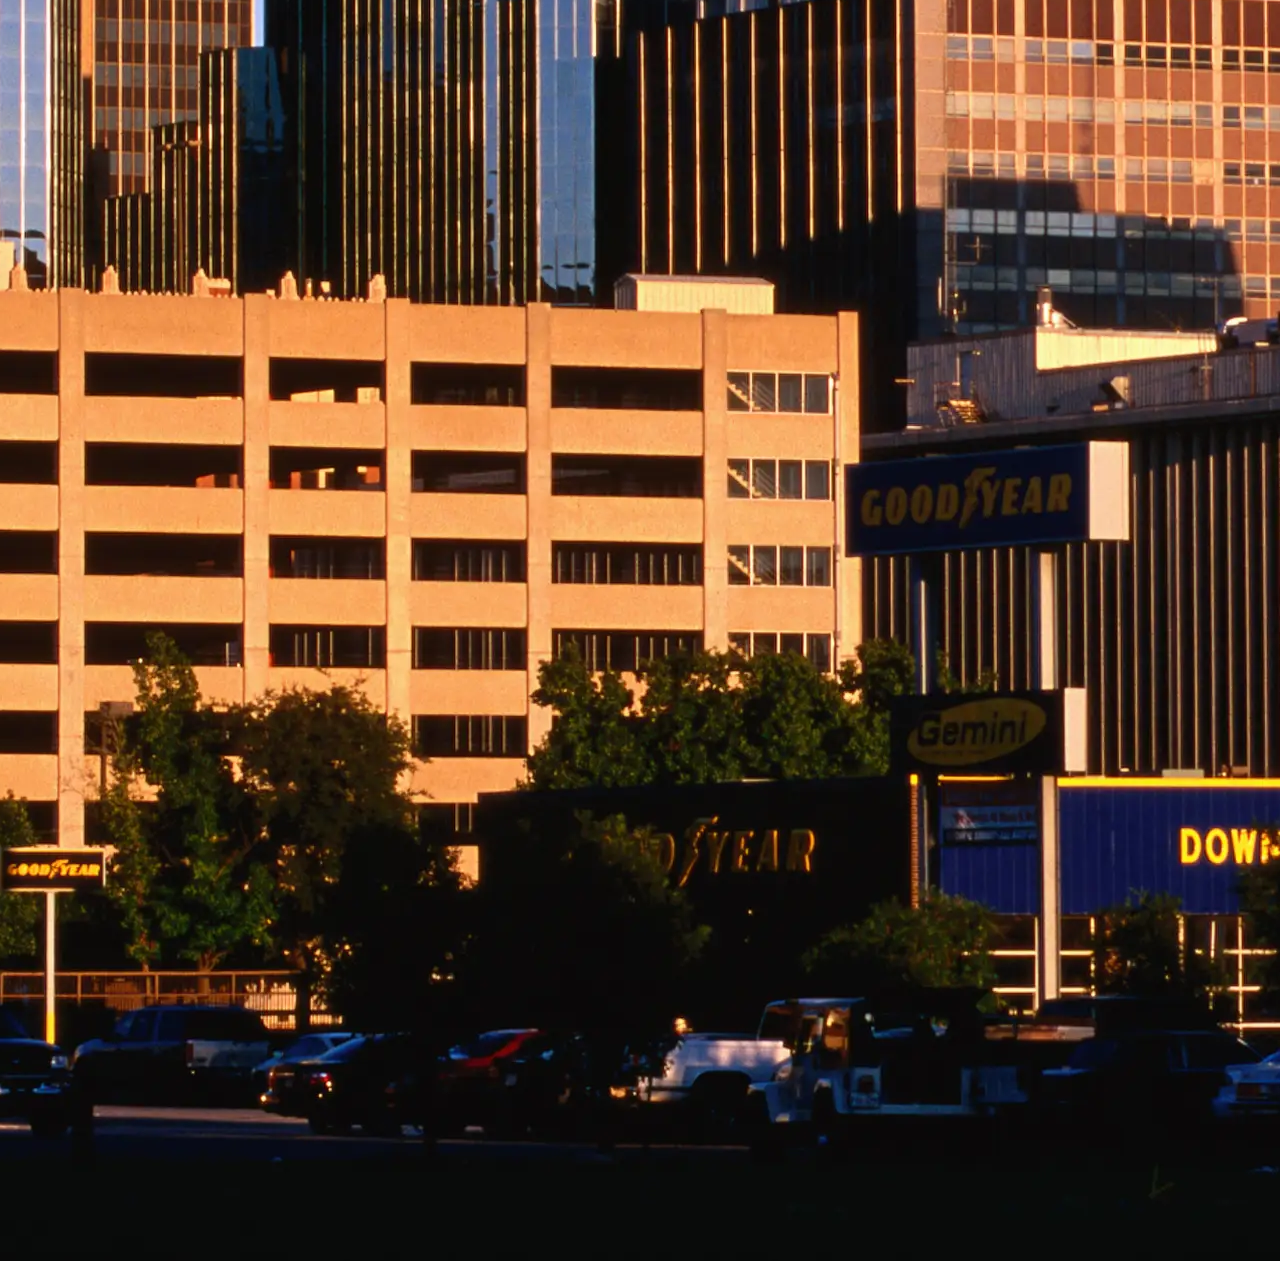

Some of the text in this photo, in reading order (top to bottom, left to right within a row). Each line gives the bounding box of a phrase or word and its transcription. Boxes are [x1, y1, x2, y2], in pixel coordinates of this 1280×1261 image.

[860, 467, 1072, 529] GOODYEAR
[917, 710, 1029, 746] Gemini
[8, 859, 99, 878] GOODYEAR
[638, 815, 817, 887] DYEAR
